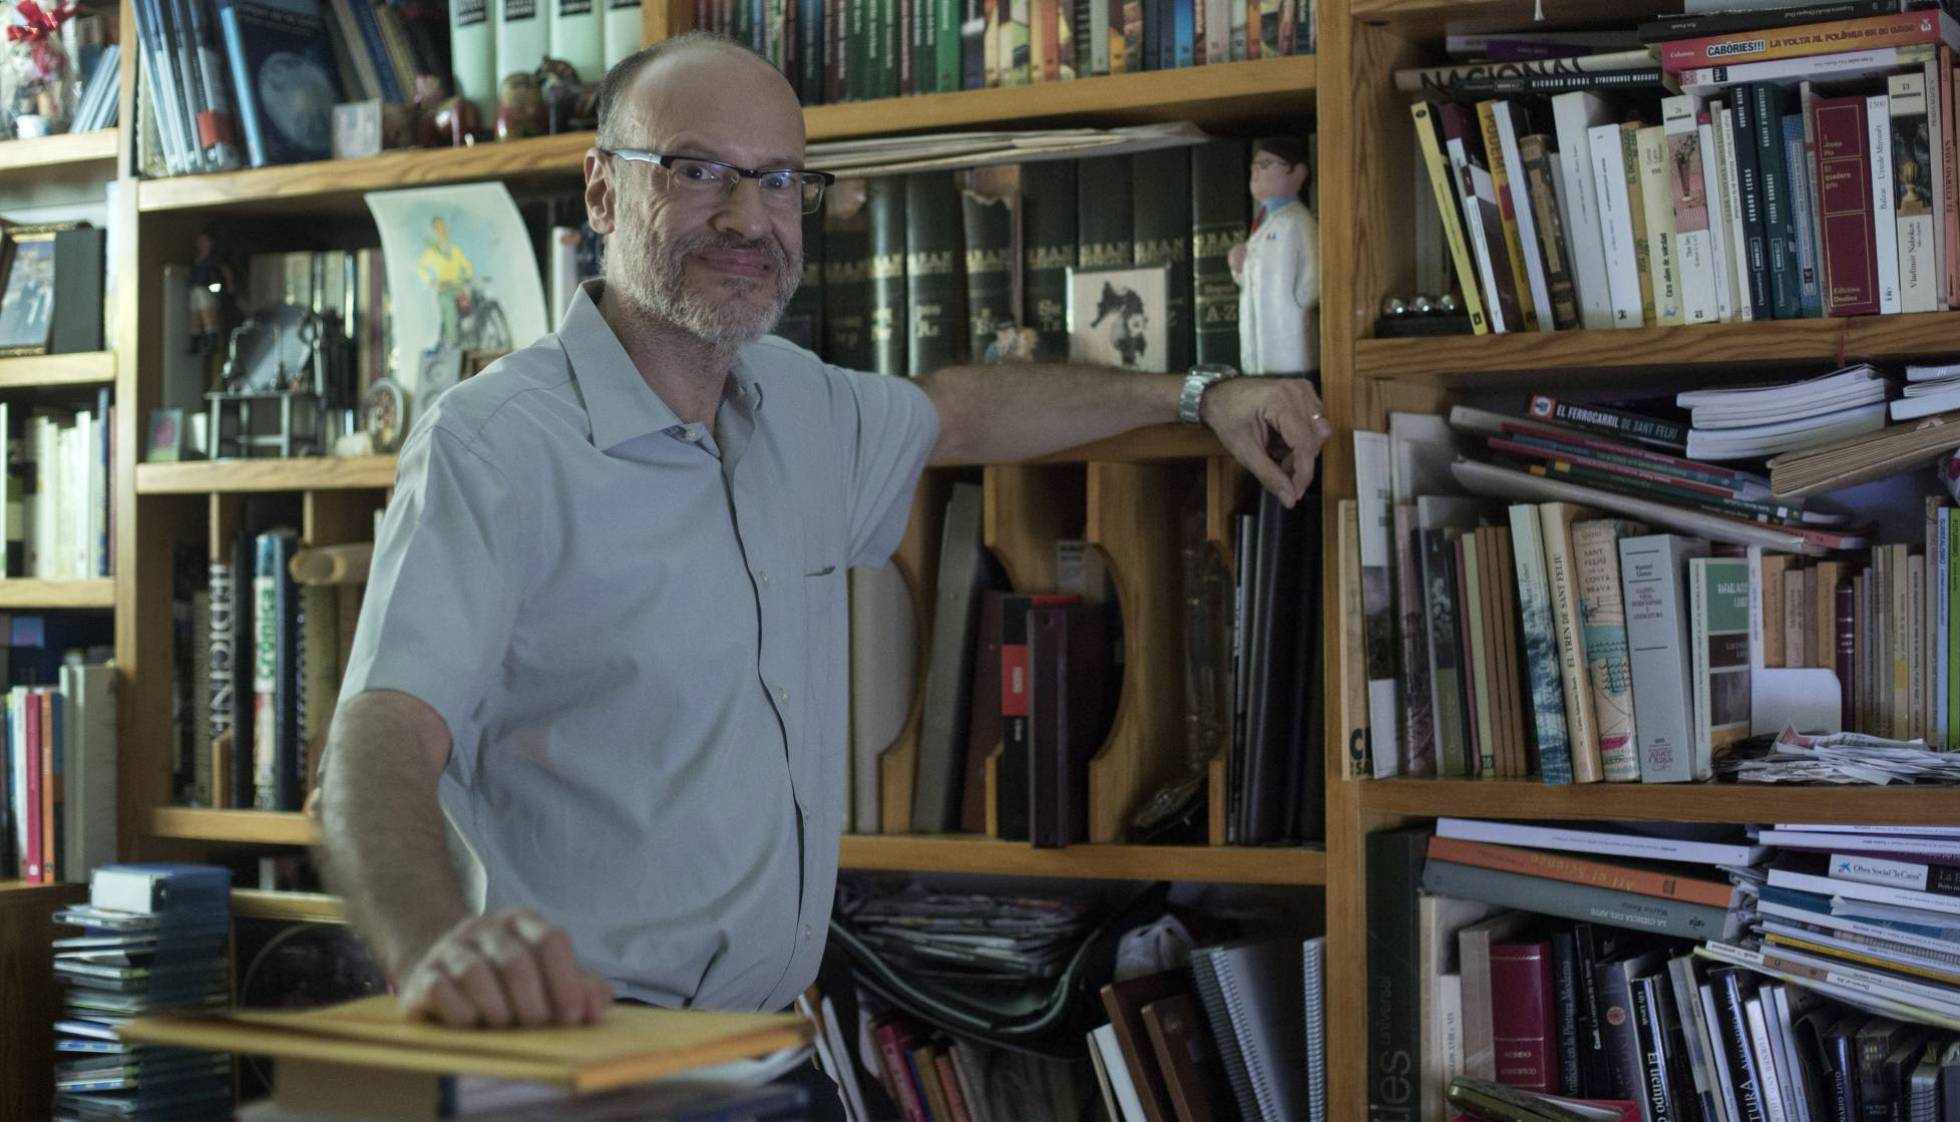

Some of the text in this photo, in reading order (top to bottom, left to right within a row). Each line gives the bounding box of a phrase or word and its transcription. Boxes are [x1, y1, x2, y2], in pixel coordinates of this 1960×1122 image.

[1556, 404, 1679, 441] EL FERROCARRIL DE SANT FELIU
[1552, 553, 1576, 668] EL TREN DE SANT FELIU
[1655, 919, 1667, 928] LA
[1649, 1067, 1667, 1116] tiempo
